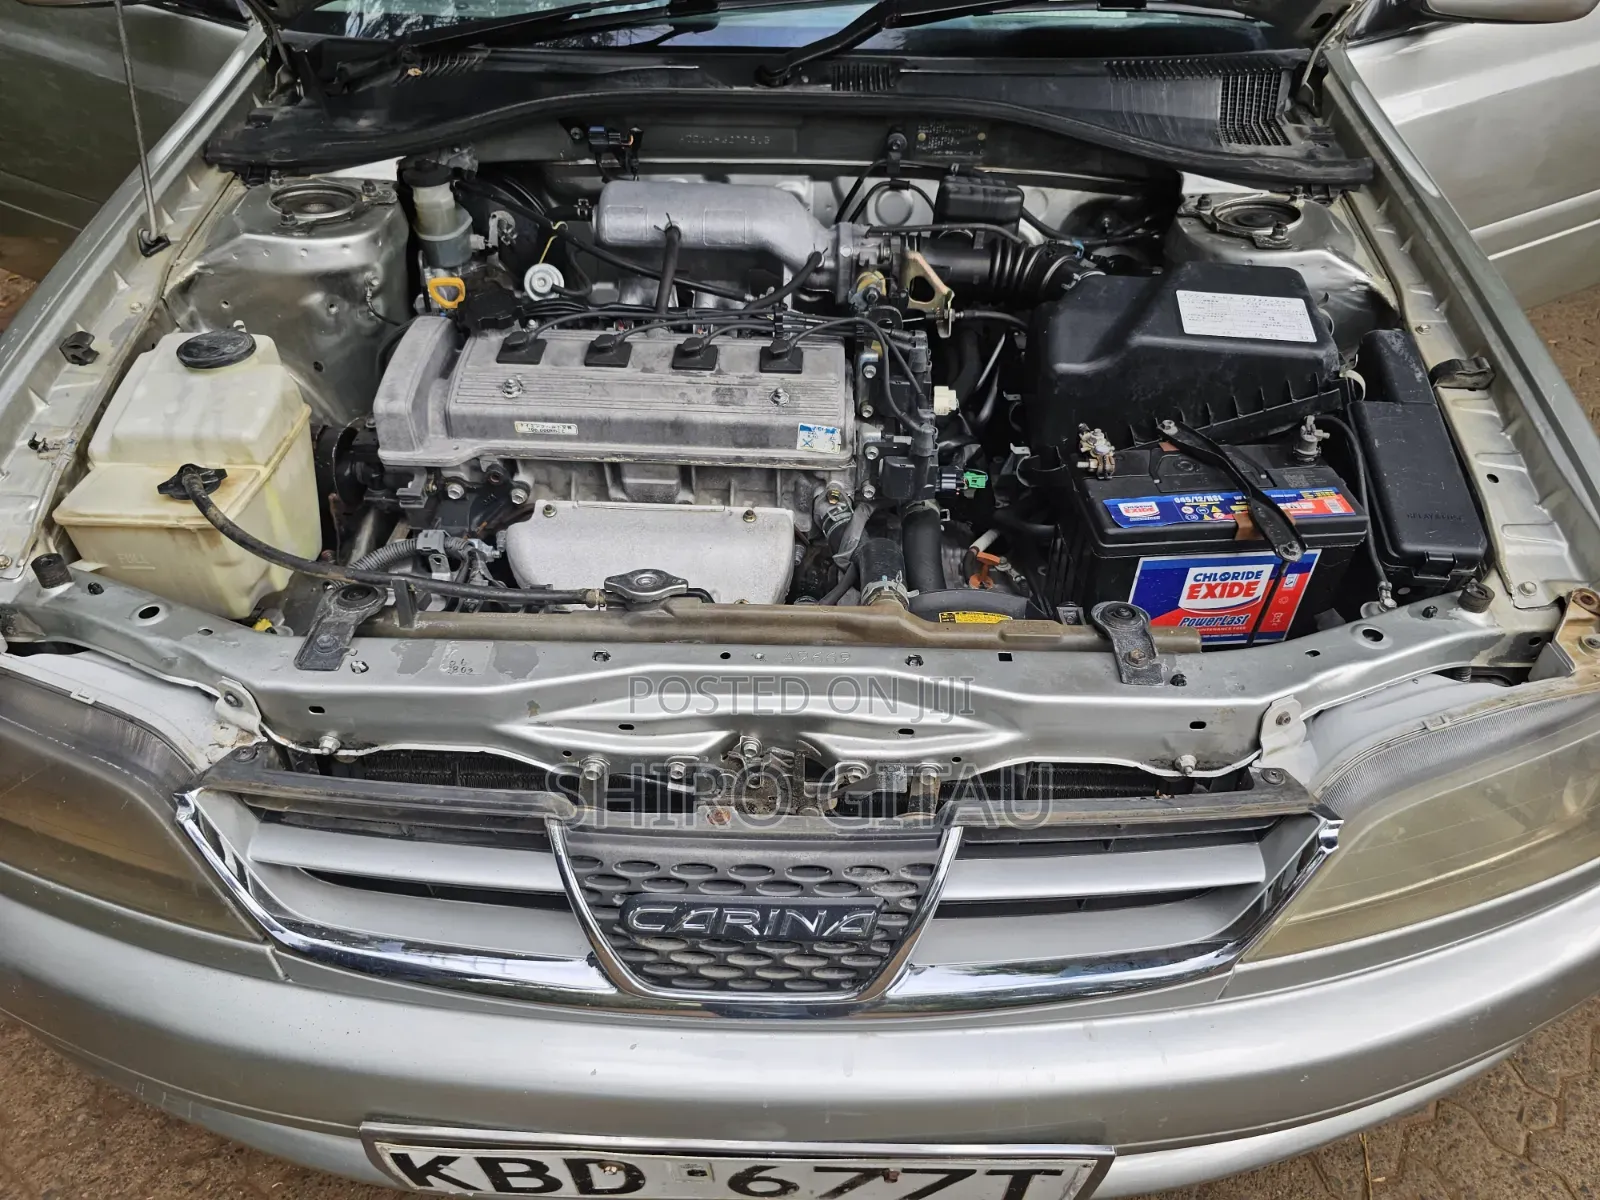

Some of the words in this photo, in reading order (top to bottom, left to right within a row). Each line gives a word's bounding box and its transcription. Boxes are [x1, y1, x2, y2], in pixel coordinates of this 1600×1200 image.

[1193, 569, 1264, 583] CHLORIDE
[1186, 580, 1260, 600] EXIDE
[627, 906, 876, 936] CARINA
[389, 1151, 647, 1196] KBD
[727, 1164, 1064, 1200] 677T
